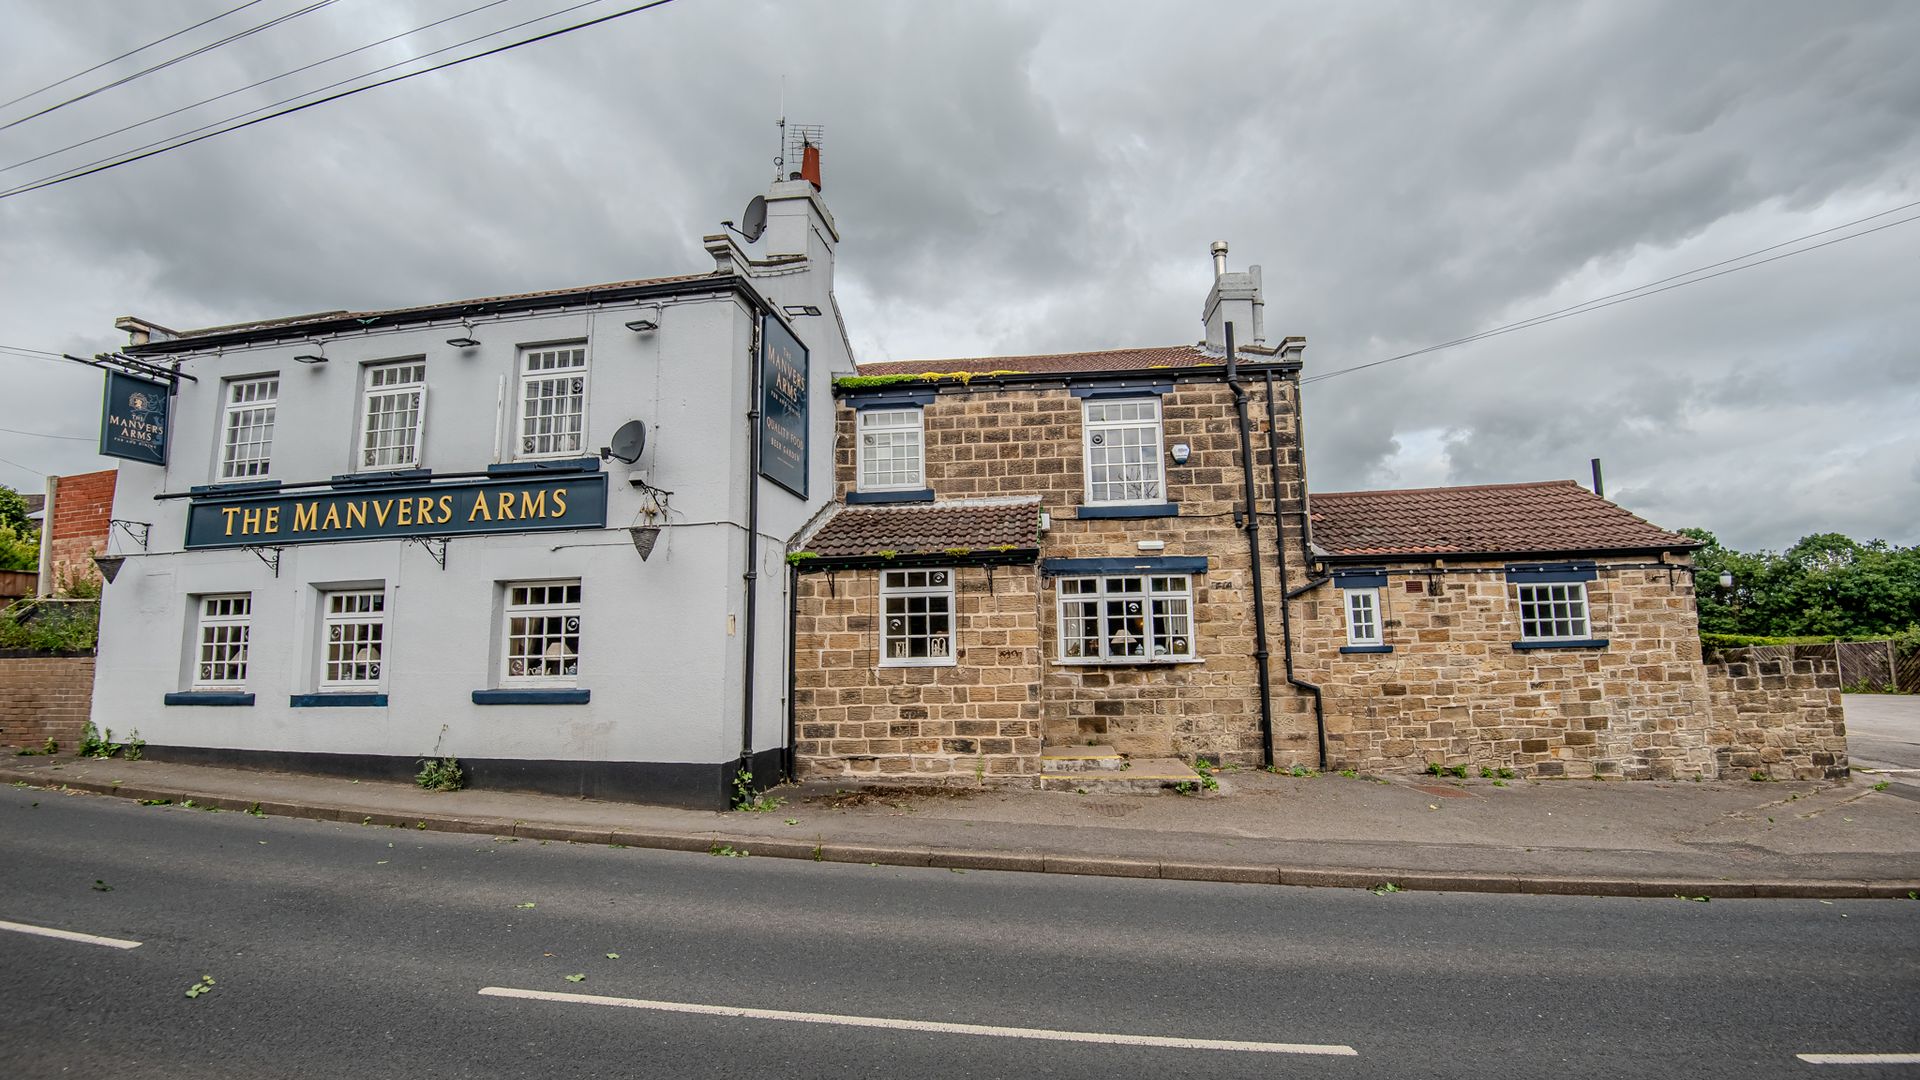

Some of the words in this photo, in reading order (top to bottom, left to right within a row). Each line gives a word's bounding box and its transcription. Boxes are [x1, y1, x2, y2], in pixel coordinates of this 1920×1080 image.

[767, 343, 805, 392] MANVERS
[776, 371, 797, 403] ARMS
[109, 414, 164, 436] MANVERS
[121, 428, 152, 442] ARMS
[766, 416, 790, 440] QUALITY
[790, 433, 804, 451] FOOD
[222, 506, 281, 536] THE
[292, 495, 453, 532] MANVERS
[468, 488, 568, 522] ARMS
